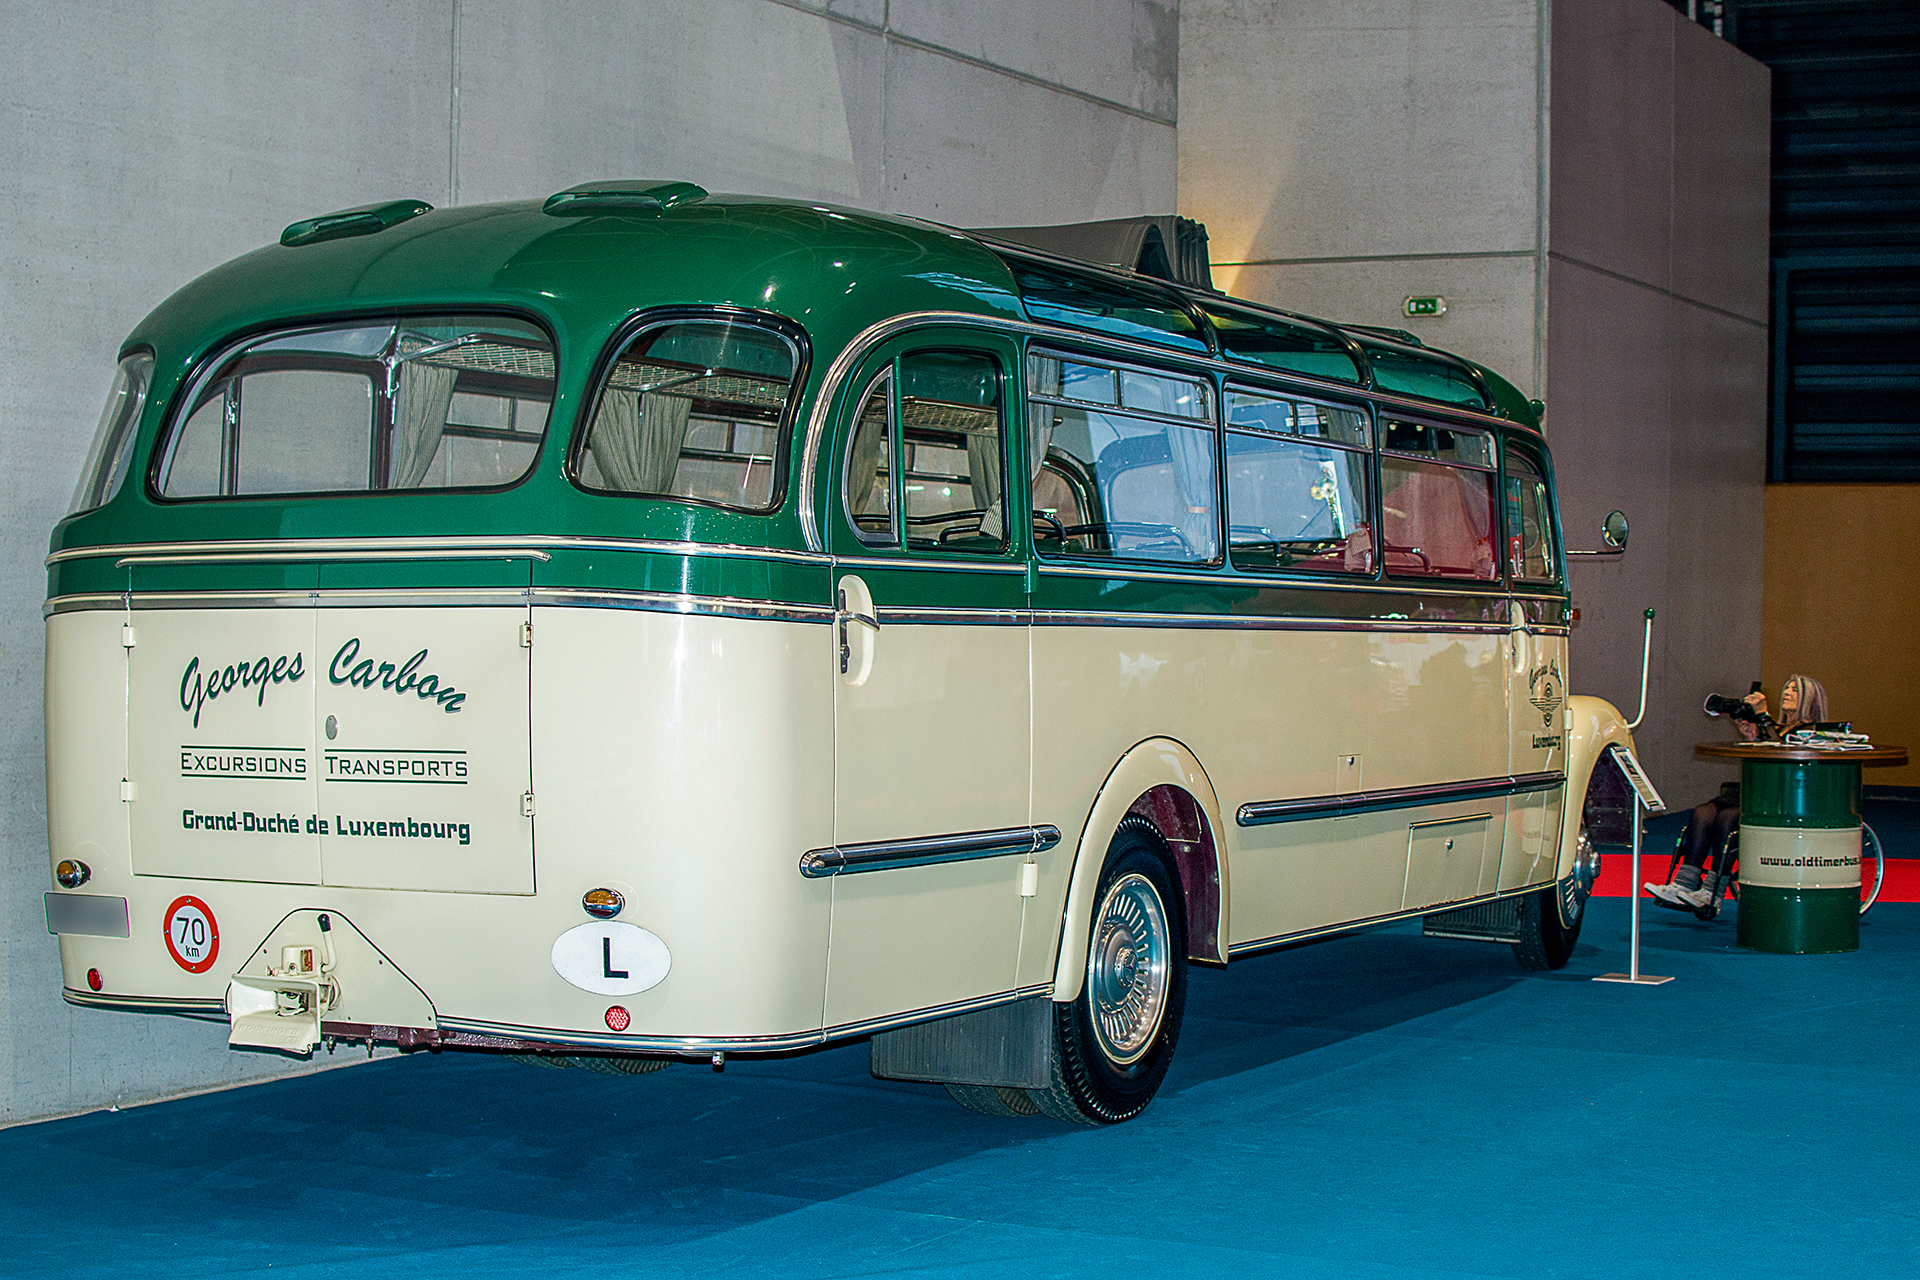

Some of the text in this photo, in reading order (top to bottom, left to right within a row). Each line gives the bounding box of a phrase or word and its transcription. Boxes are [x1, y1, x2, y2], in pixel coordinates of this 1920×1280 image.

[180, 637, 467, 728] Georges Carbon
[181, 752, 468, 777] EXCURSIONS TRANSPORTS
[182, 809, 471, 845] Grand-Duché de Luxembourg
[1760, 856, 1861, 868] www.oldtimerbus.
[176, 916, 206, 946] 70
[185, 945, 200, 958] km
[603, 937, 629, 979] L
